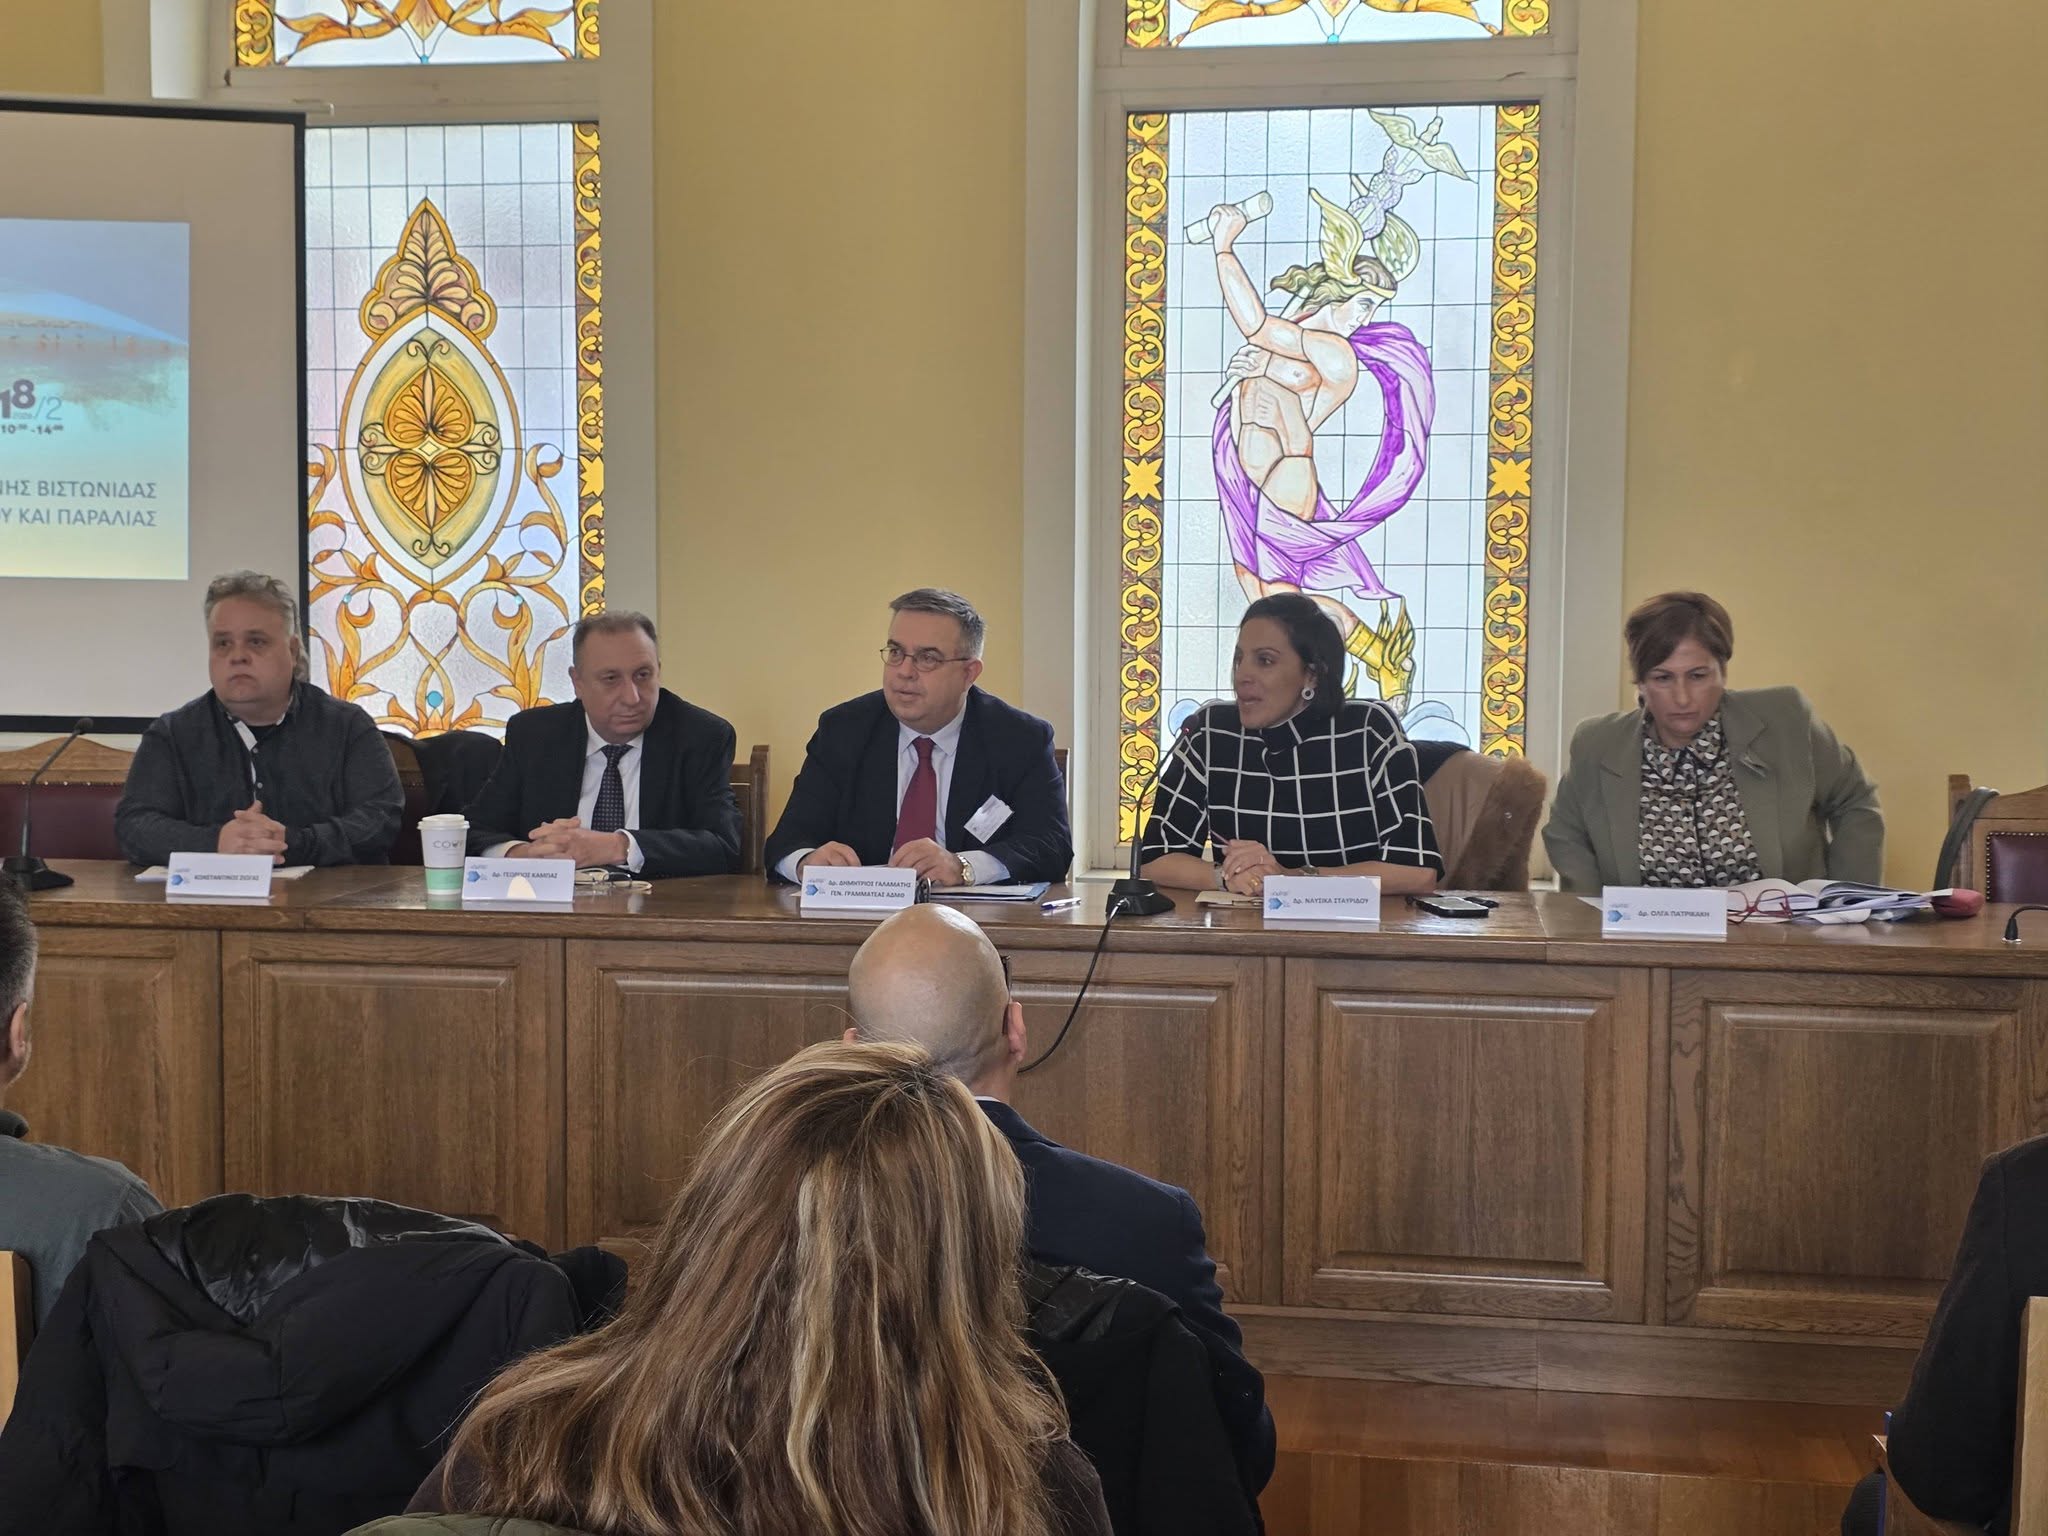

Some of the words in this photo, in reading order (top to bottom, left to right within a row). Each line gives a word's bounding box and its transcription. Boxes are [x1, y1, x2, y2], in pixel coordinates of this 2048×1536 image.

[38, 480, 157, 499] ΒΙΣΤΩΝΙΔΑΣ
[19, 508, 50, 524] ΚΑΙ
[58, 508, 157, 527] ΠΑΡΑΛΙΑΣ
